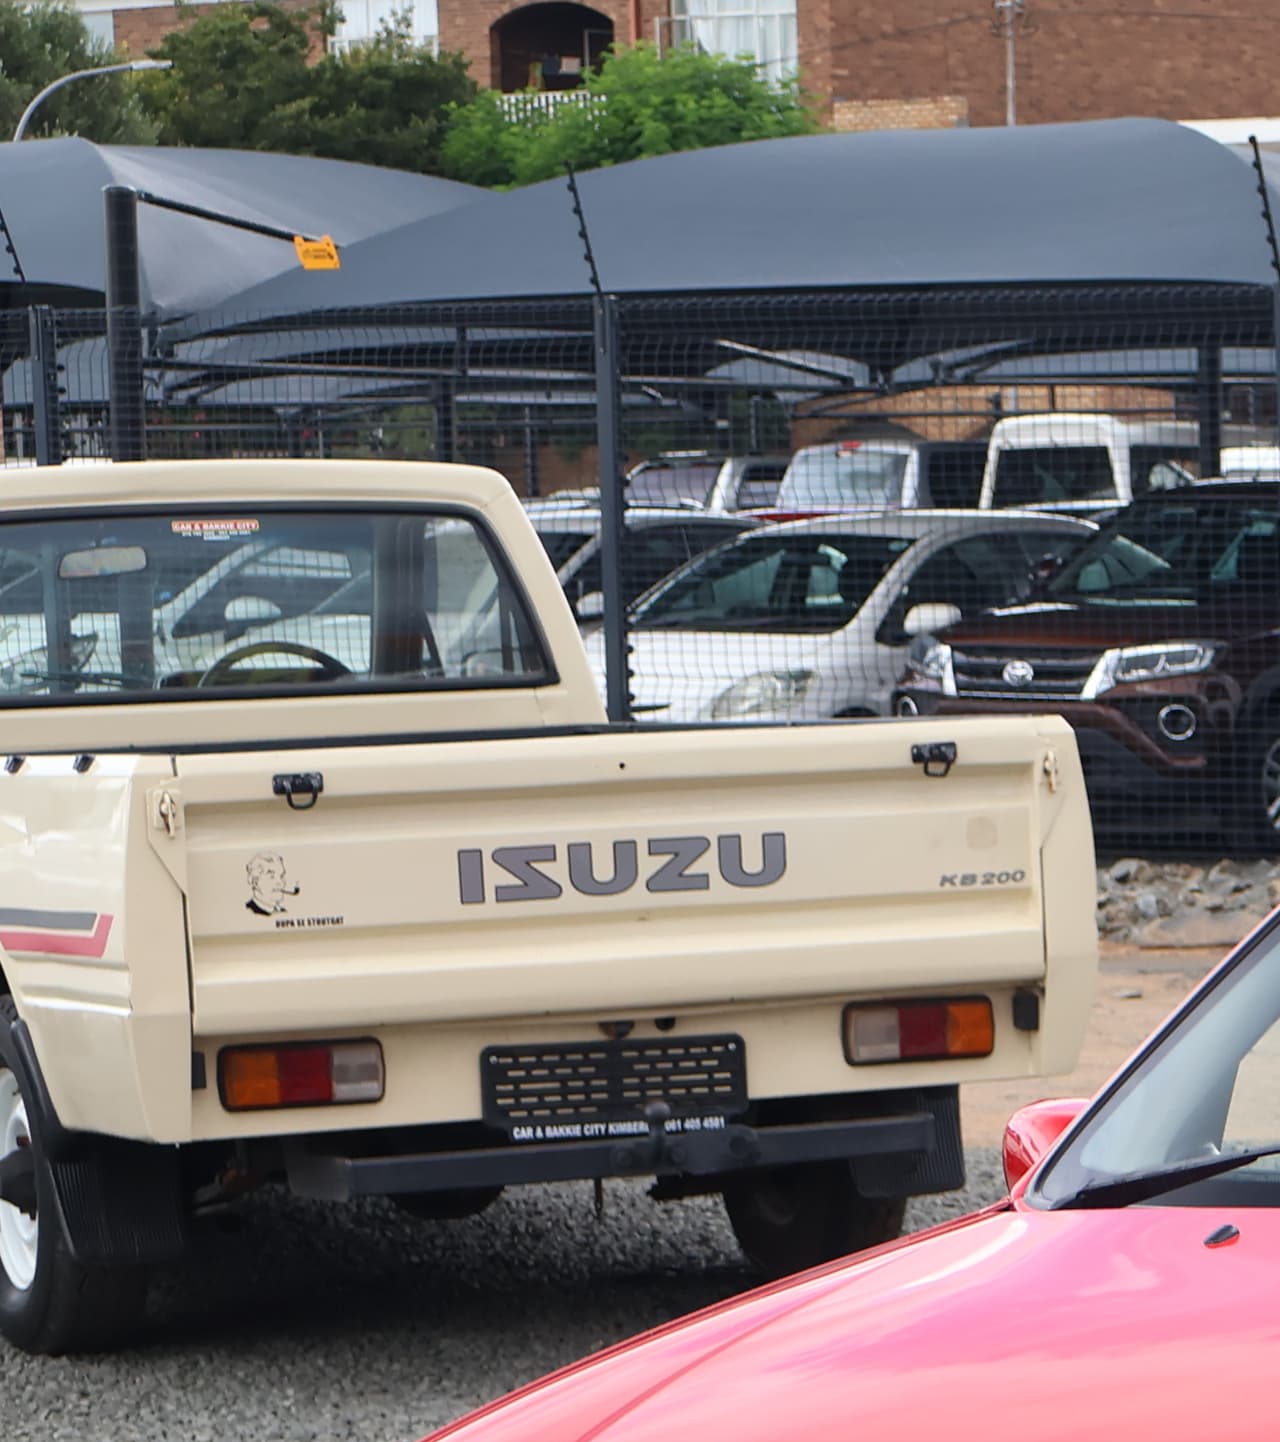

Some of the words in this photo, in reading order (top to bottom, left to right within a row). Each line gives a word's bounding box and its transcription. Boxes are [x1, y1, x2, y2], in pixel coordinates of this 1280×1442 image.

[457, 832, 787, 905] ISUZU
[939, 873, 978, 887] KB
[981, 869, 1026, 885] 200
[513, 1126, 534, 1140] CAR
[535, 1126, 544, 1139] &
[545, 1123, 582, 1138] BAKKIE
[583, 1122, 607, 1137] CITY
